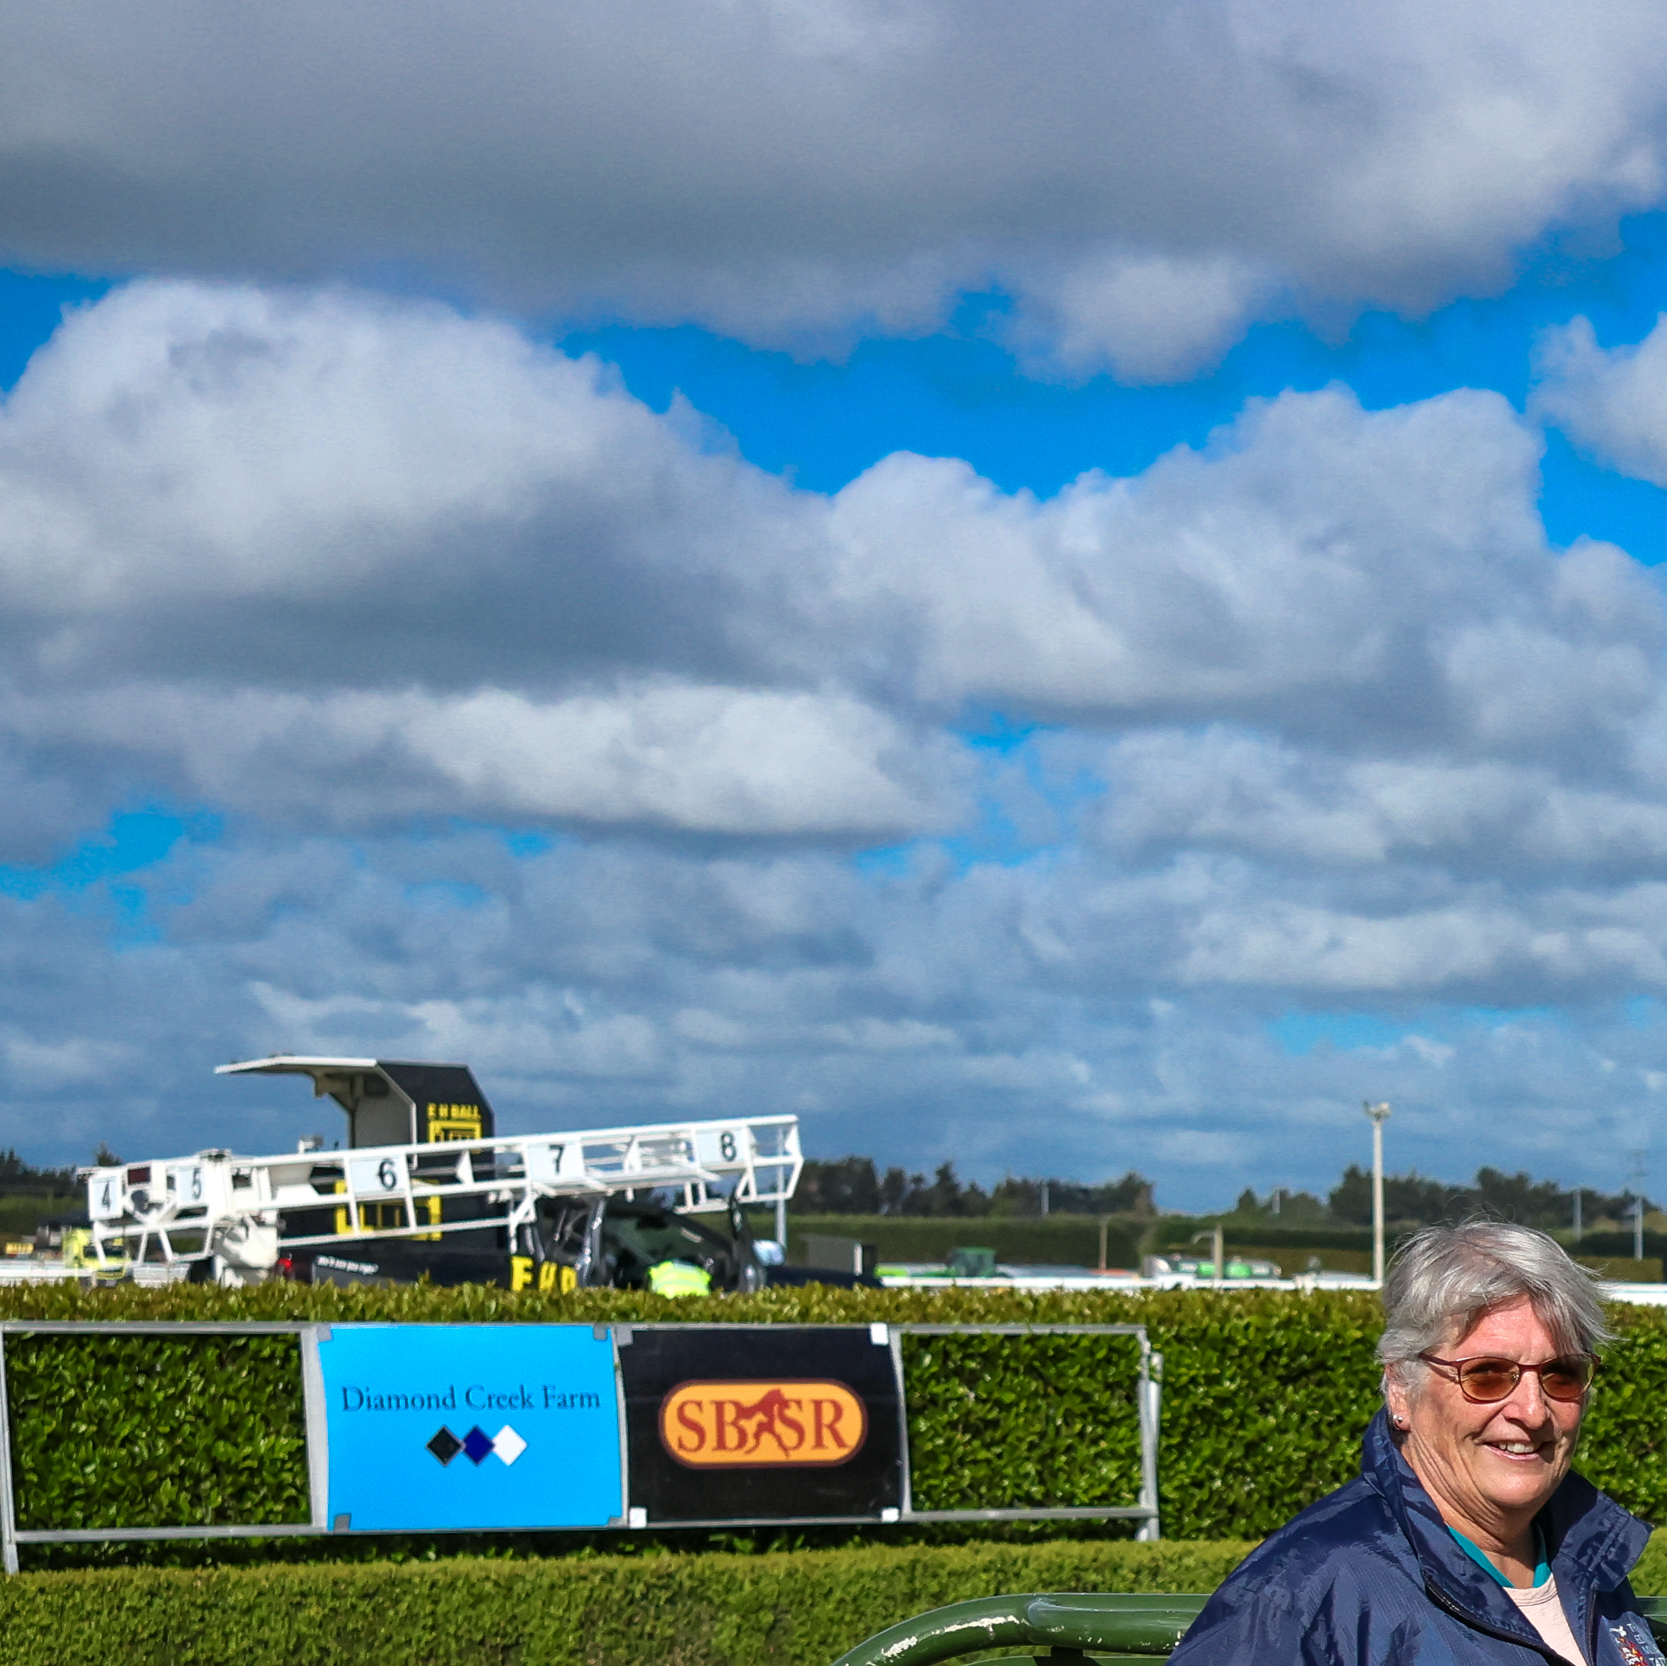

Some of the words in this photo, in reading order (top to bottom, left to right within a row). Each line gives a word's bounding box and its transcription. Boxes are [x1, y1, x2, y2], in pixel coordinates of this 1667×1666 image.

[547, 1145, 564, 1174] 7
[720, 1130, 737, 1162] 8
[191, 1168, 202, 1200] 5
[378, 1158, 398, 1191] 6
[101, 1180, 112, 1211] 4
[341, 1384, 456, 1412] Diamond
[464, 1383, 534, 1411] Creek
[541, 1384, 601, 1410] Farm
